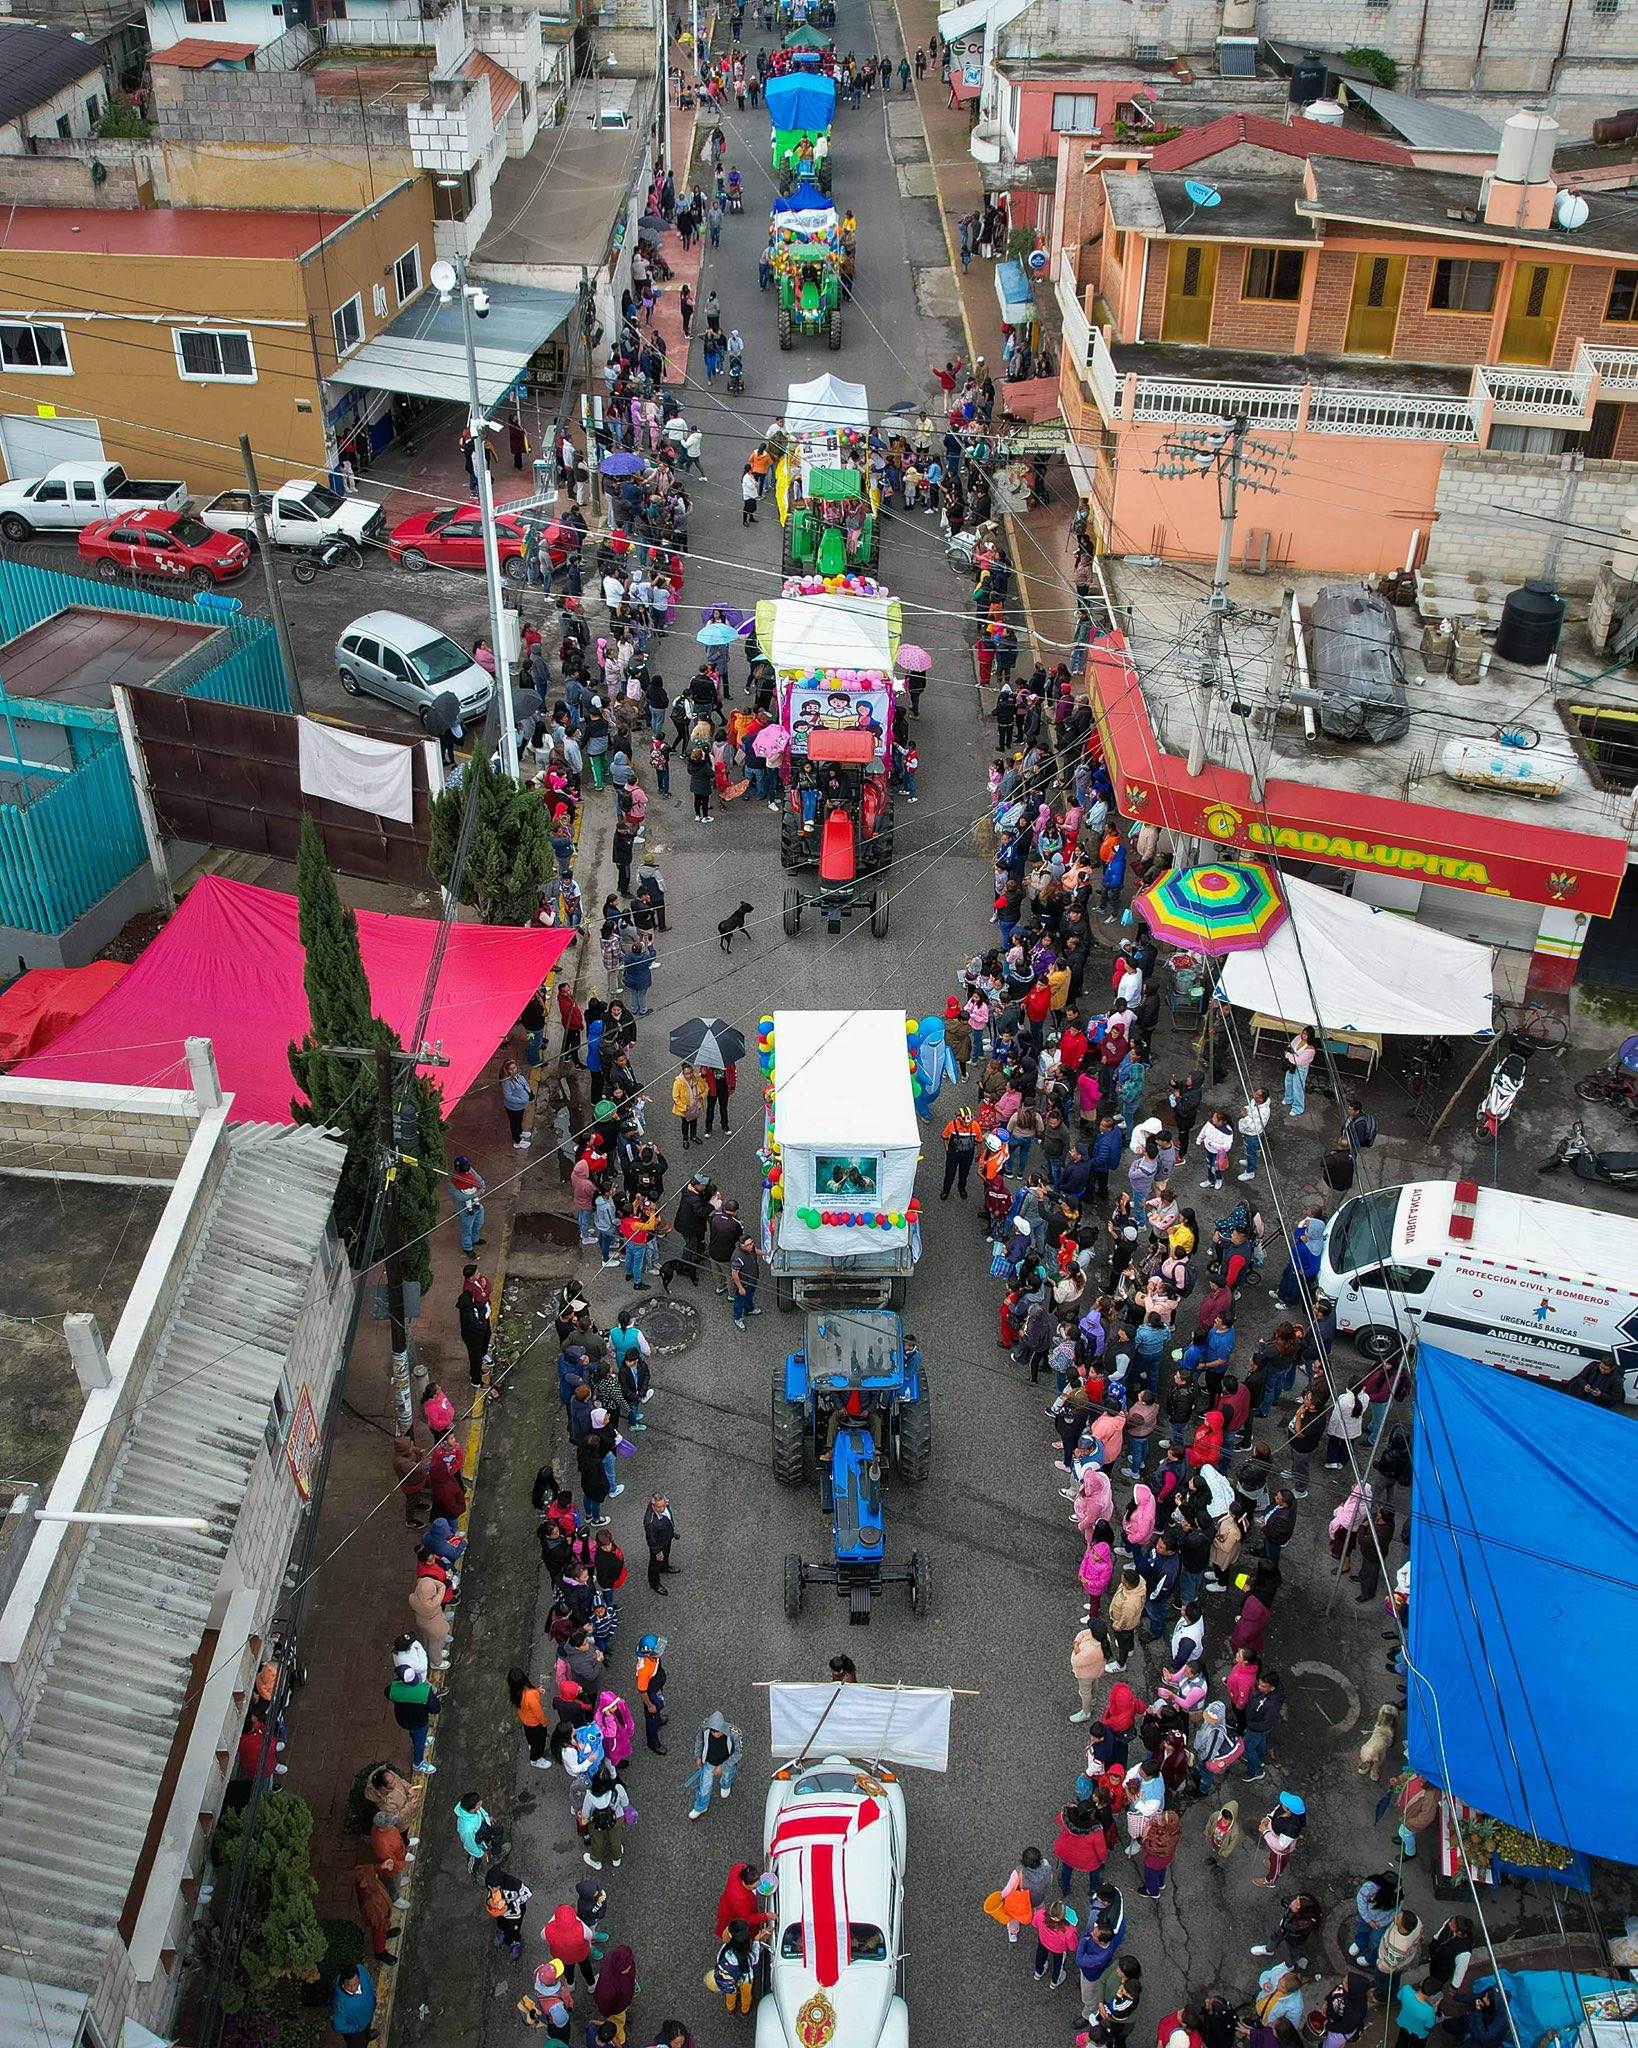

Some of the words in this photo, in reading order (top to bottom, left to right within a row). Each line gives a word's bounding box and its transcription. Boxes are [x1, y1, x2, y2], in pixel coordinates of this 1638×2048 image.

[1028, 429, 1066, 440] MOSCOS
[1455, 1266, 1517, 1285] PROTECCIÓN
[1519, 1280, 1545, 1292] CIVIL
[1556, 1289, 1610, 1306] BOMBEROS
[1500, 1314, 1543, 1330] URGENCIAS
[1544, 1324, 1578, 1337] BASICAS
[1486, 1328, 1581, 1355] AMBULANCIA
